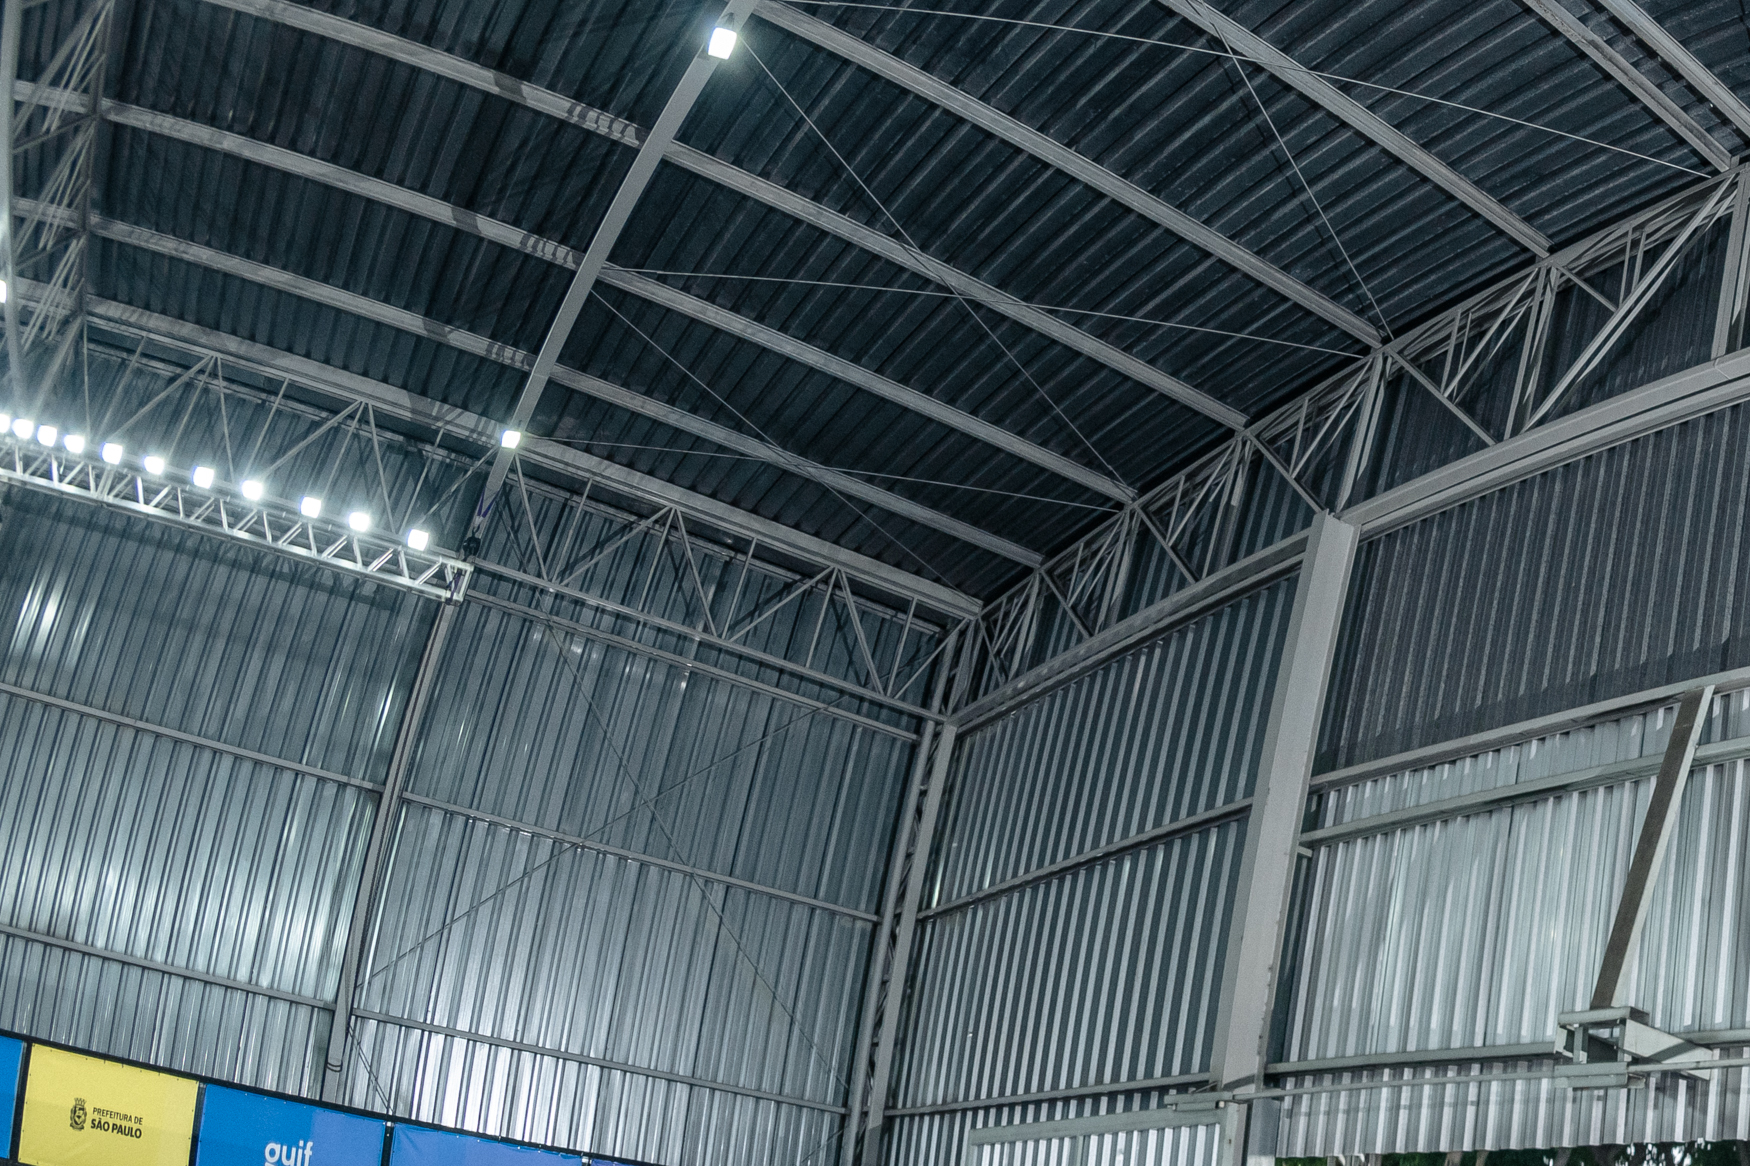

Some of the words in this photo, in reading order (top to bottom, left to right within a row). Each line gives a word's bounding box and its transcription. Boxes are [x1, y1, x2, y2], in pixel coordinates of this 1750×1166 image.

[92, 1107, 132, 1123] PREFEITURA
[133, 1116, 143, 1126] DE
[90, 1117, 110, 1132] SÃO
[111, 1123, 142, 1139] PAULO
